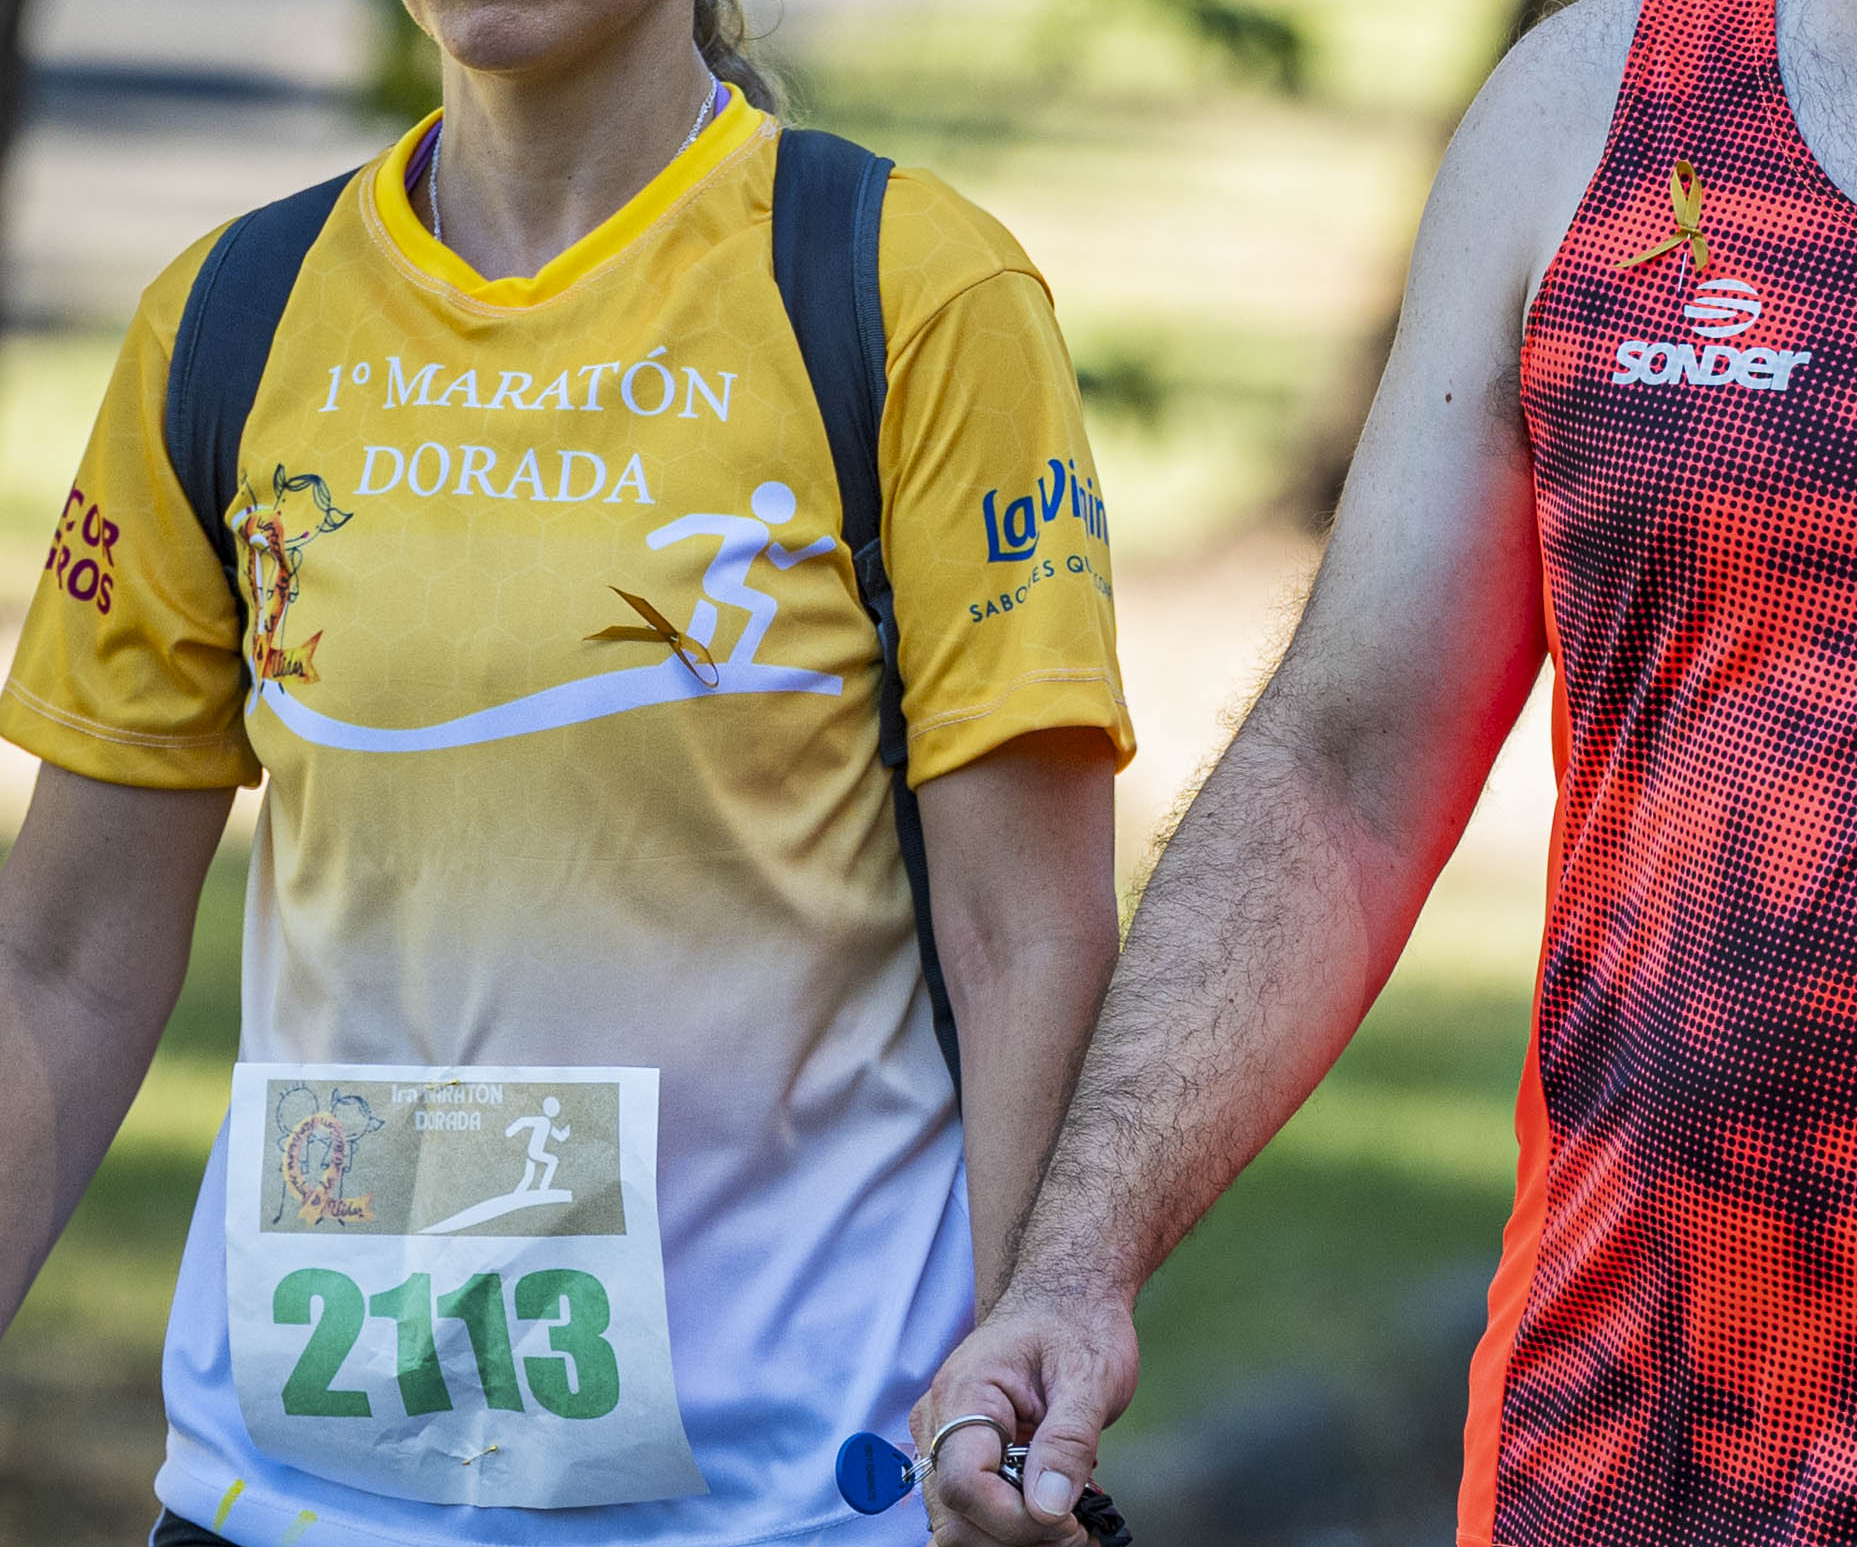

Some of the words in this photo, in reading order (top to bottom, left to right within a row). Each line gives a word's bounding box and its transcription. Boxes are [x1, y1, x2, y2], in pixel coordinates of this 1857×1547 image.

[353, 440, 657, 505] DORADA
[969, 559, 1056, 623] SABOES
[415, 1110, 481, 1132] DORADA
[272, 1267, 621, 1420] 2113
